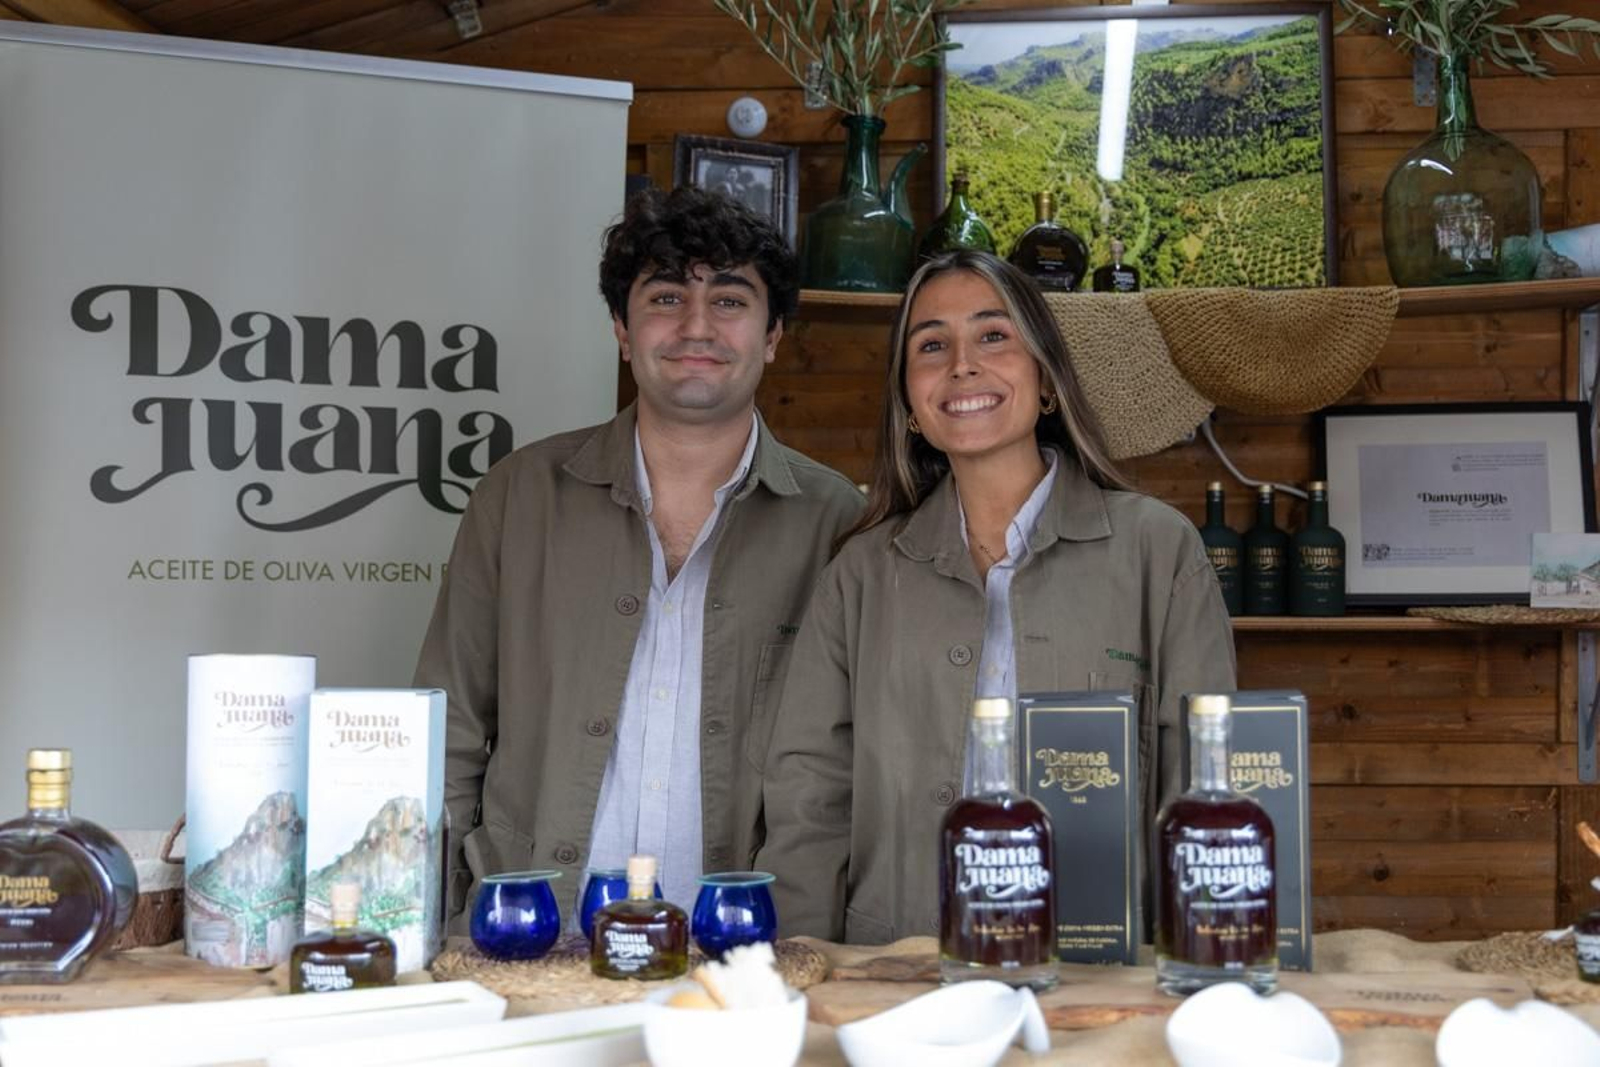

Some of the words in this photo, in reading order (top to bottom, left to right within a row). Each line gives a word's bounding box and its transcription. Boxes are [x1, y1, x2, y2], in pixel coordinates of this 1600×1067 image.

[71, 285, 499, 393] Dama
[90, 397, 513, 532] Juana
[127, 560, 214, 580] ACEITE
[223, 560, 254, 581] DE
[263, 560, 335, 582] OLIVA
[342, 561, 432, 583] VIRGEN
[214, 691, 286, 707] Dama
[216, 708, 295, 733] Juana
[326, 710, 400, 728] Dama
[329, 729, 411, 753] Juana
[1036, 748, 1110, 767] Dama
[1231, 751, 1282, 767] ama
[1039, 767, 1120, 792] Juana
[1230, 767, 1293, 793] uana
[955, 843, 1041, 867] Dama
[1175, 843, 1263, 866] Dama
[959, 865, 1050, 898] Juana
[1180, 864, 1272, 898] Juana
[605, 931, 648, 943] Dama
[301, 962, 346, 975] Dama
